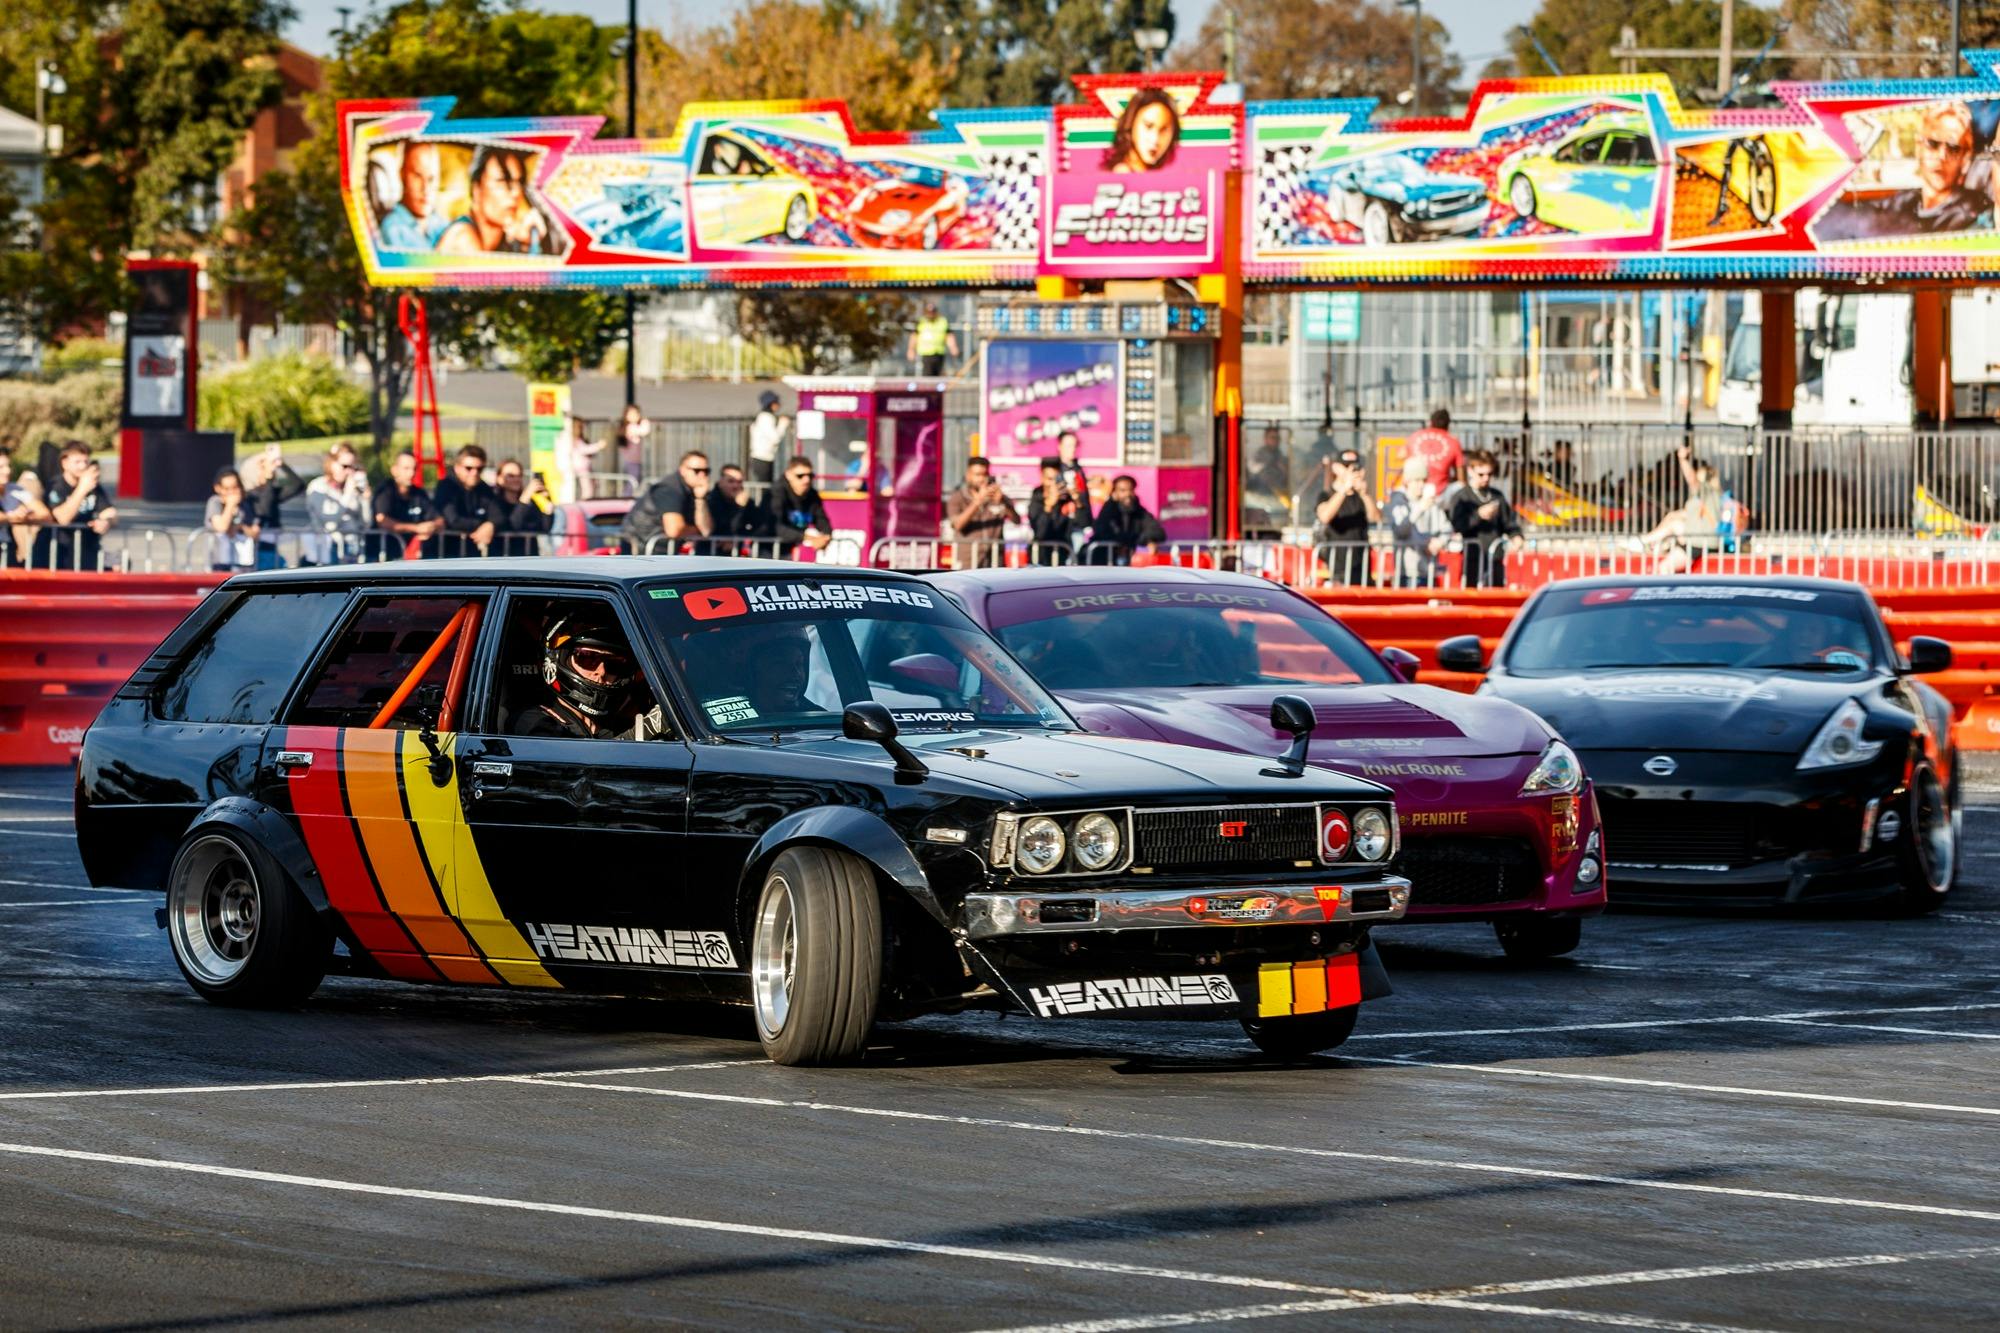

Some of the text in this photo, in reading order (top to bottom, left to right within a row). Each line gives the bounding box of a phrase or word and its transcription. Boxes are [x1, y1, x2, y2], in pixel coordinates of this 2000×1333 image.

[1181, 186, 1201, 213] &
[744, 584, 934, 609] KLINGBERG
[1053, 591, 1270, 610] DRIFT CADET
[751, 600, 864, 613] MOTORSPORT
[706, 700, 752, 716] ENTRANT
[722, 710, 749, 722] 2551
[1360, 762, 1468, 777] KINCROME
[1411, 811, 1468, 827] PENRITE
[1219, 821, 1248, 837] GT
[1317, 889, 1340, 901] TOW
[525, 921, 709, 967] HEATWAVE
[1028, 975, 1213, 1018] HEATWAVE
